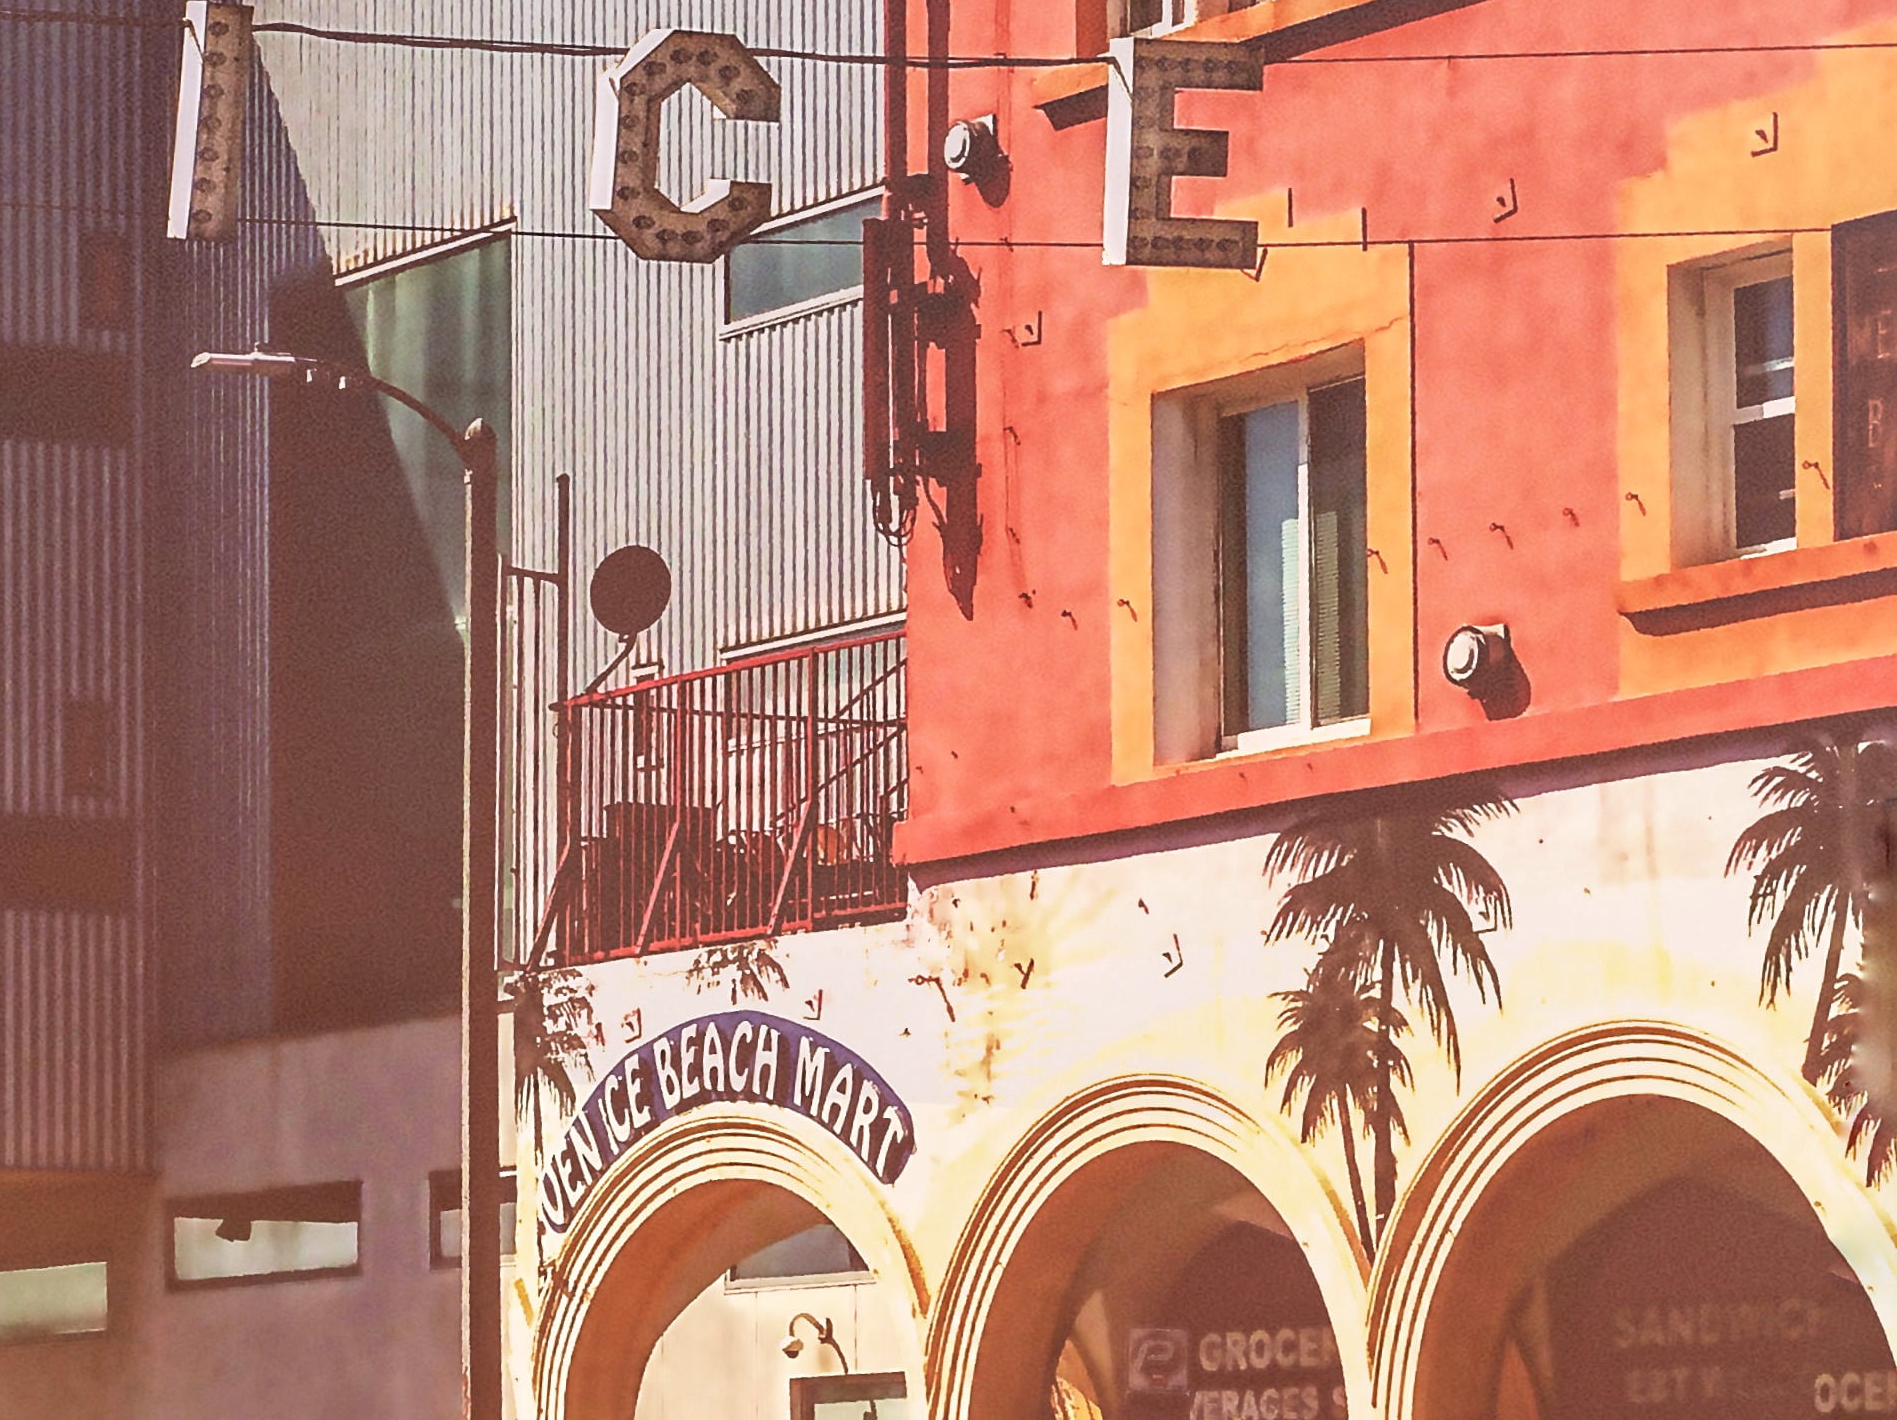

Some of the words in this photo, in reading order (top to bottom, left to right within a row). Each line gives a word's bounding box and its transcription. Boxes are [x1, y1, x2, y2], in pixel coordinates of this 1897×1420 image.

[536, 1052, 652, 1226] VENICE
[653, 1020, 782, 1112] BEACH
[794, 1035, 906, 1177] MART
